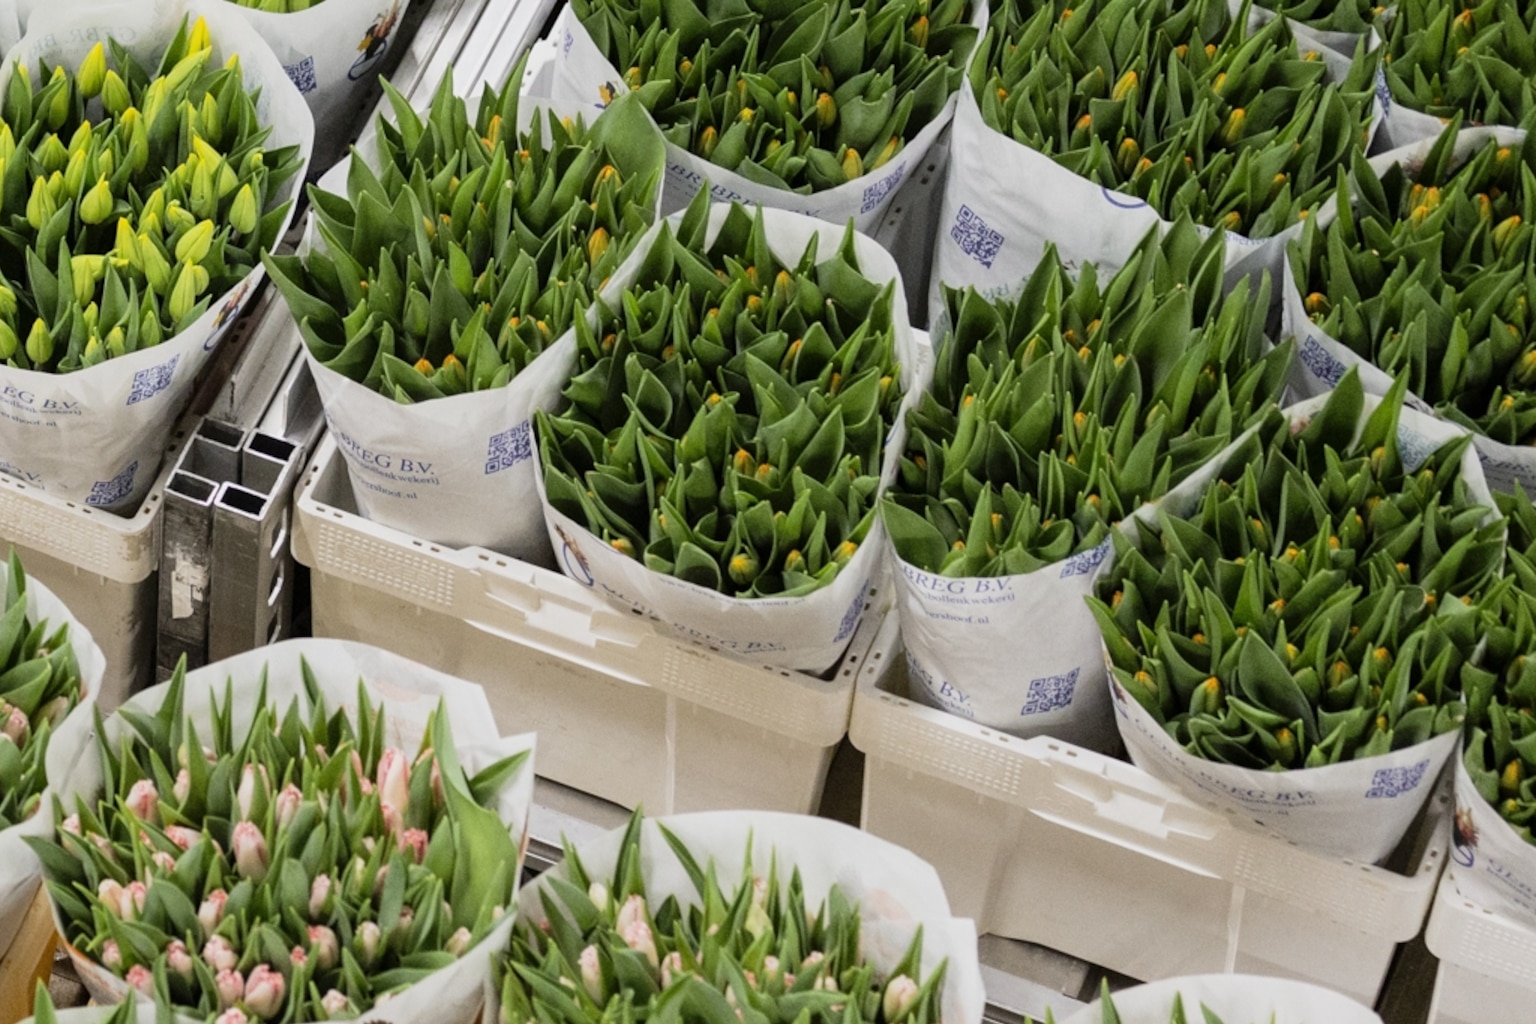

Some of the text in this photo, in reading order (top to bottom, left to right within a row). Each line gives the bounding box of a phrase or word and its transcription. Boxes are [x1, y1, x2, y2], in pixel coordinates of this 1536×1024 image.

[42, 399, 79, 411] B.V.
[340, 431, 435, 476] BREG B.V.
[903, 565, 1013, 595] BREG B.V.
[939, 680, 972, 708] B.V.
